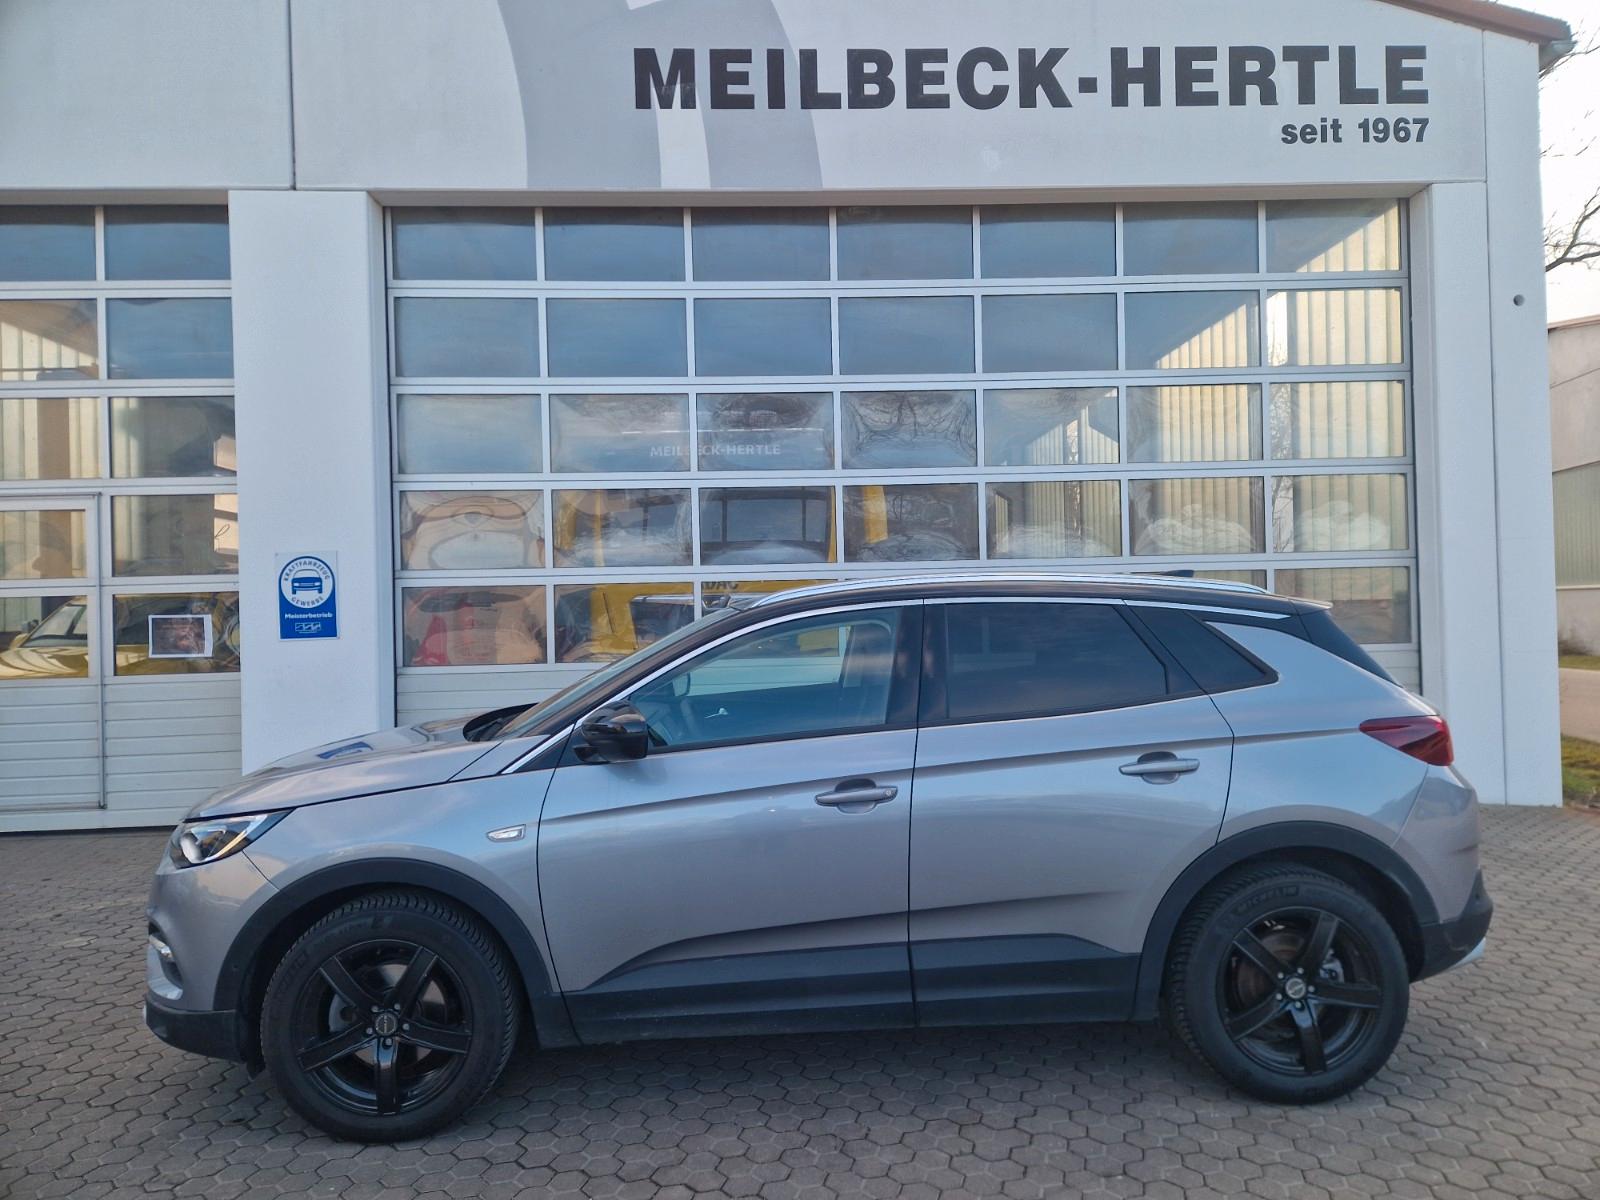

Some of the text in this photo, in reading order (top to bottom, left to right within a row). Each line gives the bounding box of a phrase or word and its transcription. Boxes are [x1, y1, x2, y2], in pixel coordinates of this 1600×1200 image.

[634, 46, 1428, 109] MEILBECK-HERTLE
[1281, 117, 1429, 144] seit 1967
[650, 444, 781, 457] MEILECK-HERTLE
[292, 596, 324, 607] GEWERBE
[284, 612, 333, 620] Meisterbetrieb
